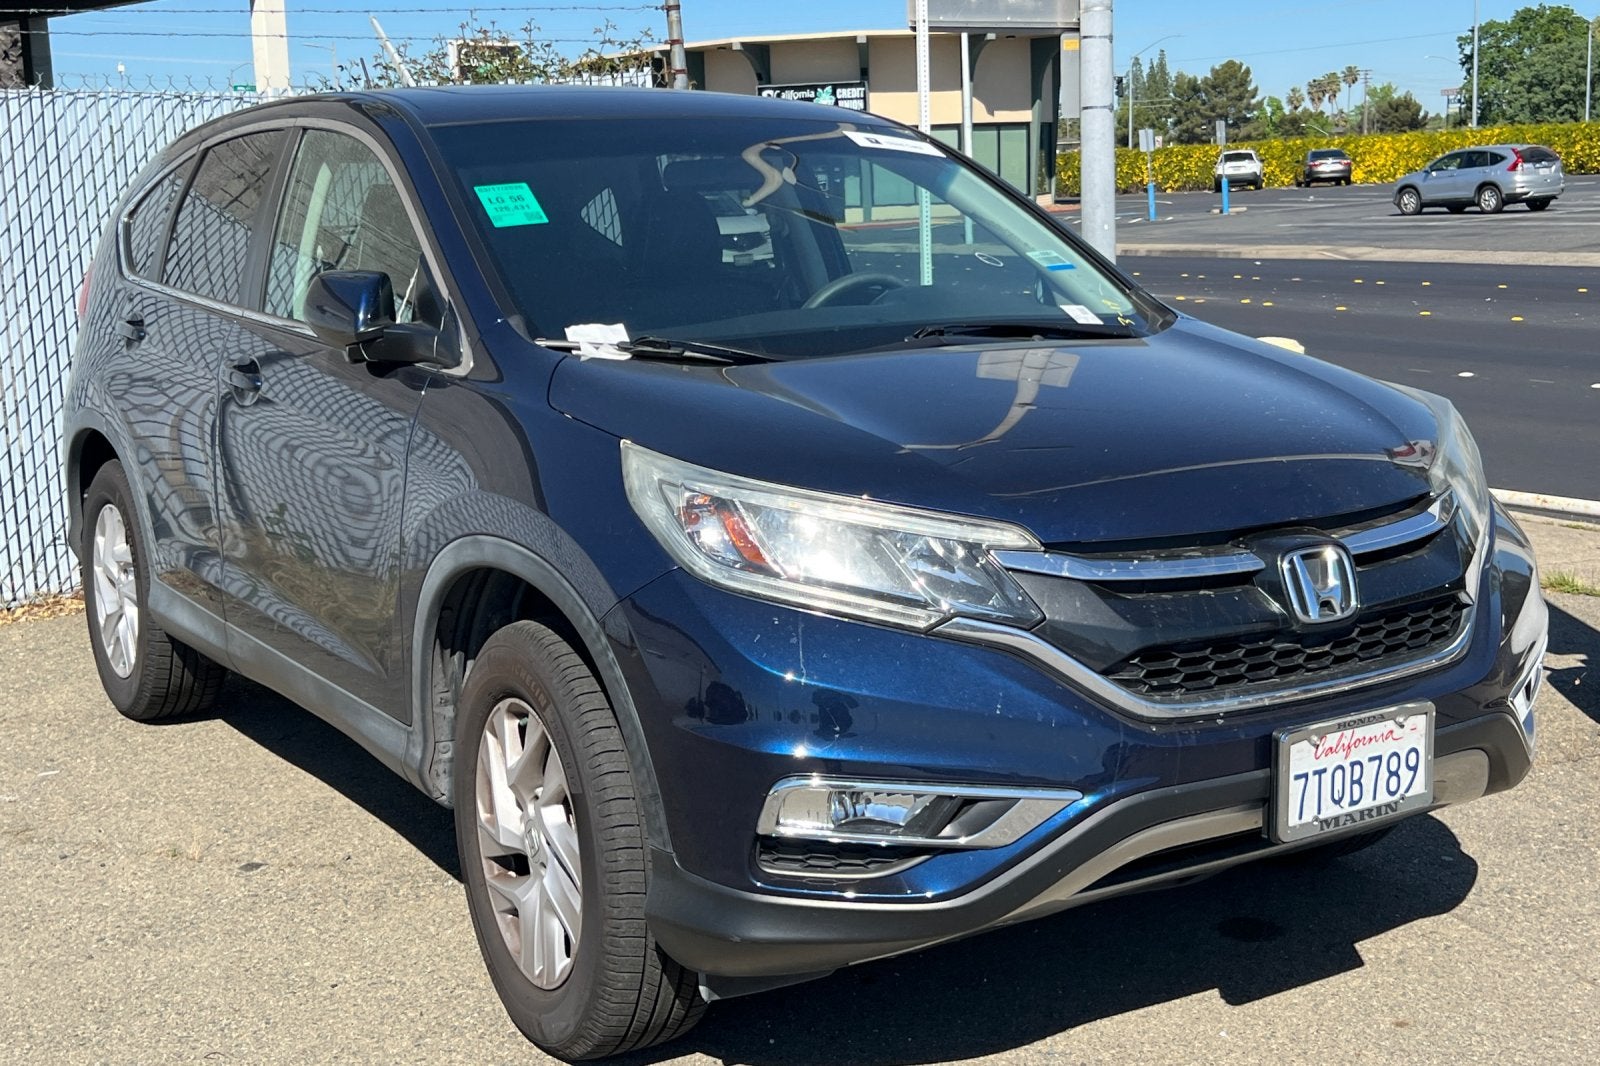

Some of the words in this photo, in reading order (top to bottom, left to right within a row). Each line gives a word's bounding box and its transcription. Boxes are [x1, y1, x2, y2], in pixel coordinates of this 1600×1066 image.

[774, 89, 815, 100] California
[836, 88, 865, 99] CREDIT
[838, 99, 864, 110] UNION
[502, 662, 548, 708] ICHELIN
[1336, 713, 1386, 730] HONDA
[1314, 728, 1403, 760] California
[1293, 747, 1420, 820] 7TQB789
[1319, 801, 1398, 831] MARIN
